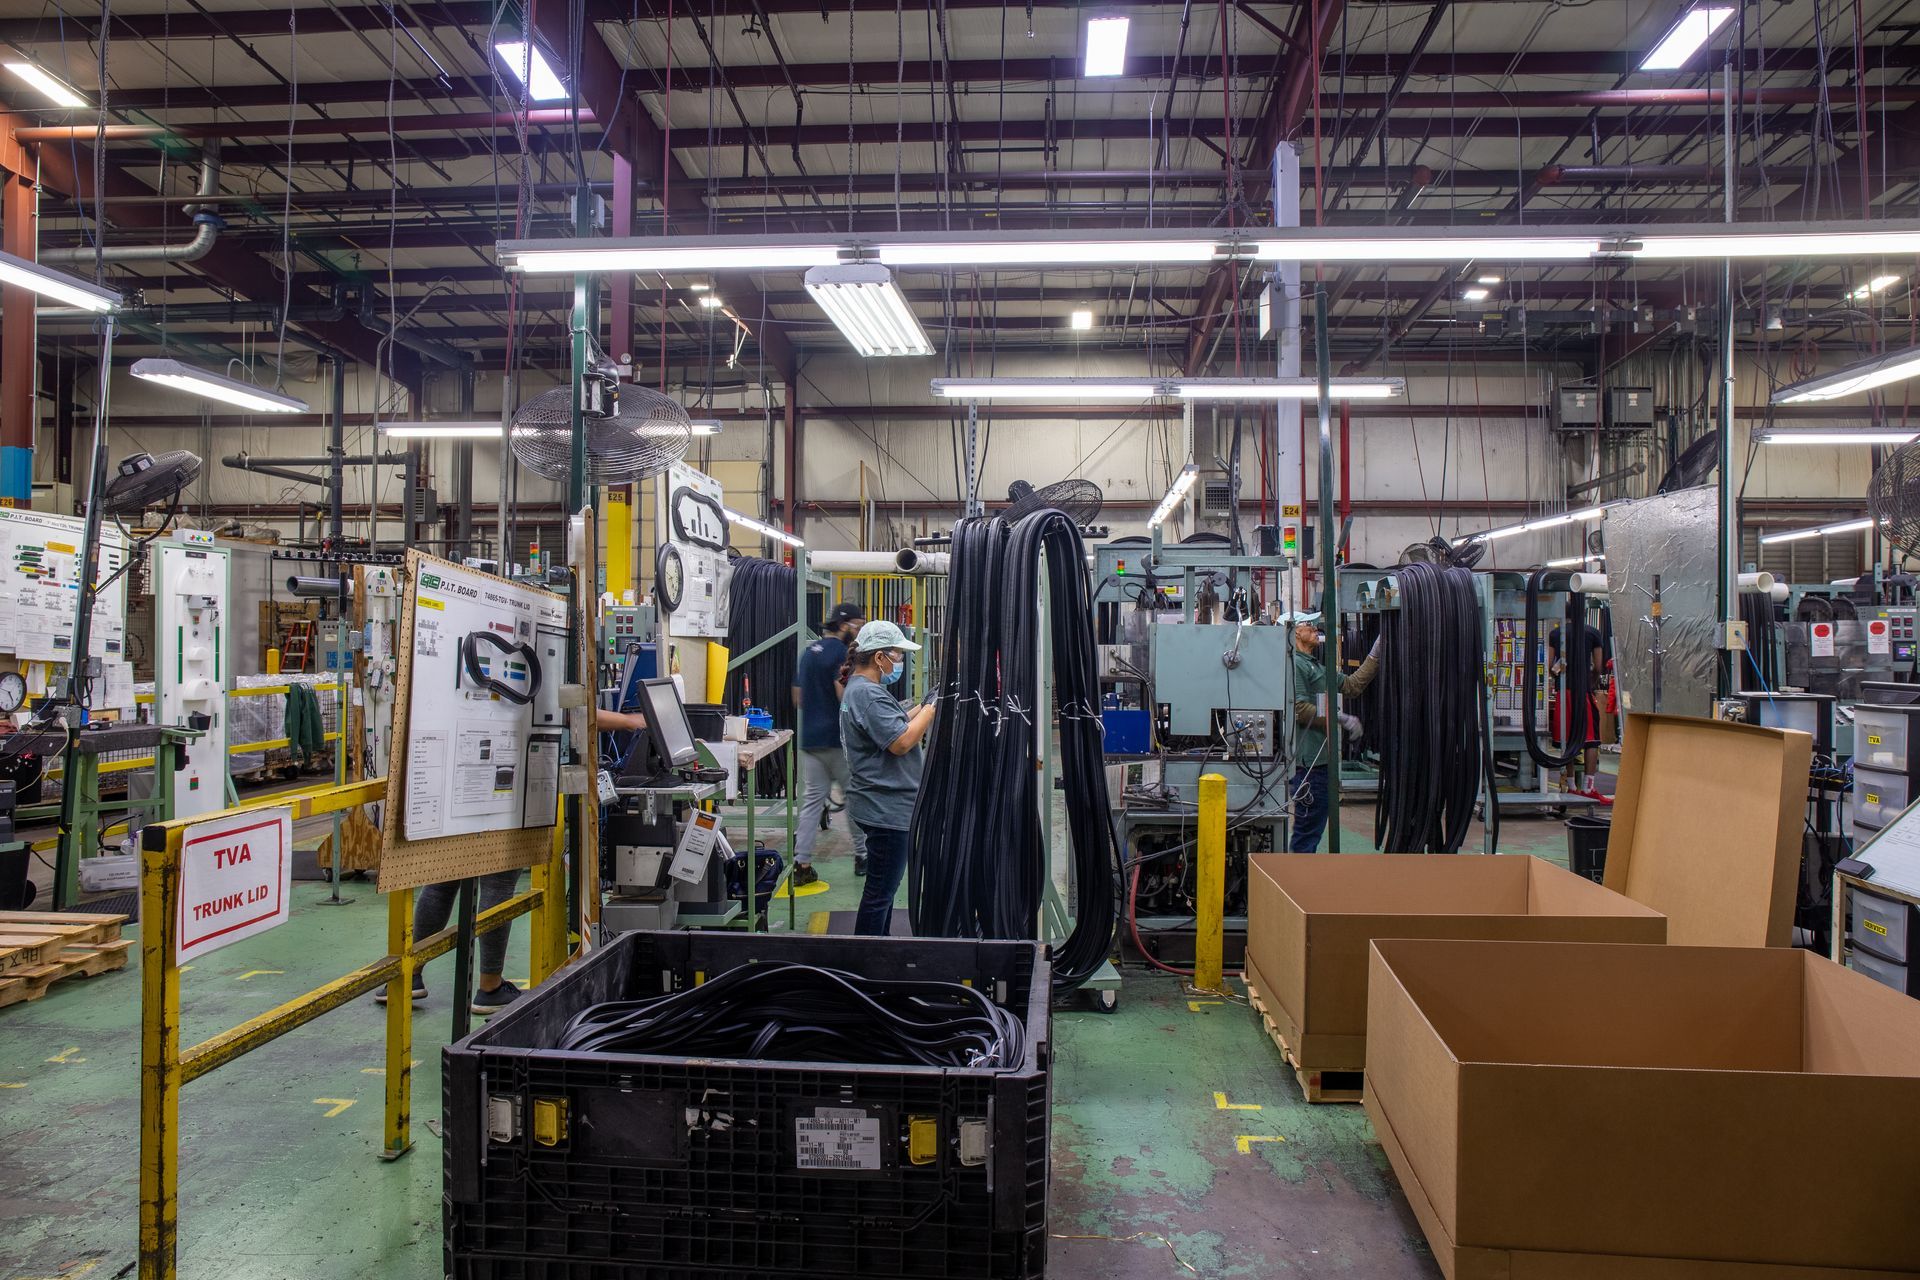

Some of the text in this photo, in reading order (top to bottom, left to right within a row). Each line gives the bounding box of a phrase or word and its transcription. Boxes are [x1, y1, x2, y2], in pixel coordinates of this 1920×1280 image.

[608, 492, 623, 501] E25
[1284, 506, 1299, 515] E24
[440, 581, 456, 593] P.I.T.
[457, 585, 478, 598] BOARD
[509, 598, 523, 608] TRUNK
[1868, 736, 1881, 744] TVA
[213, 843, 252, 870] TVA
[193, 885, 269, 921] TRUNK LID
[1864, 920, 1886, 935] SERVICE
